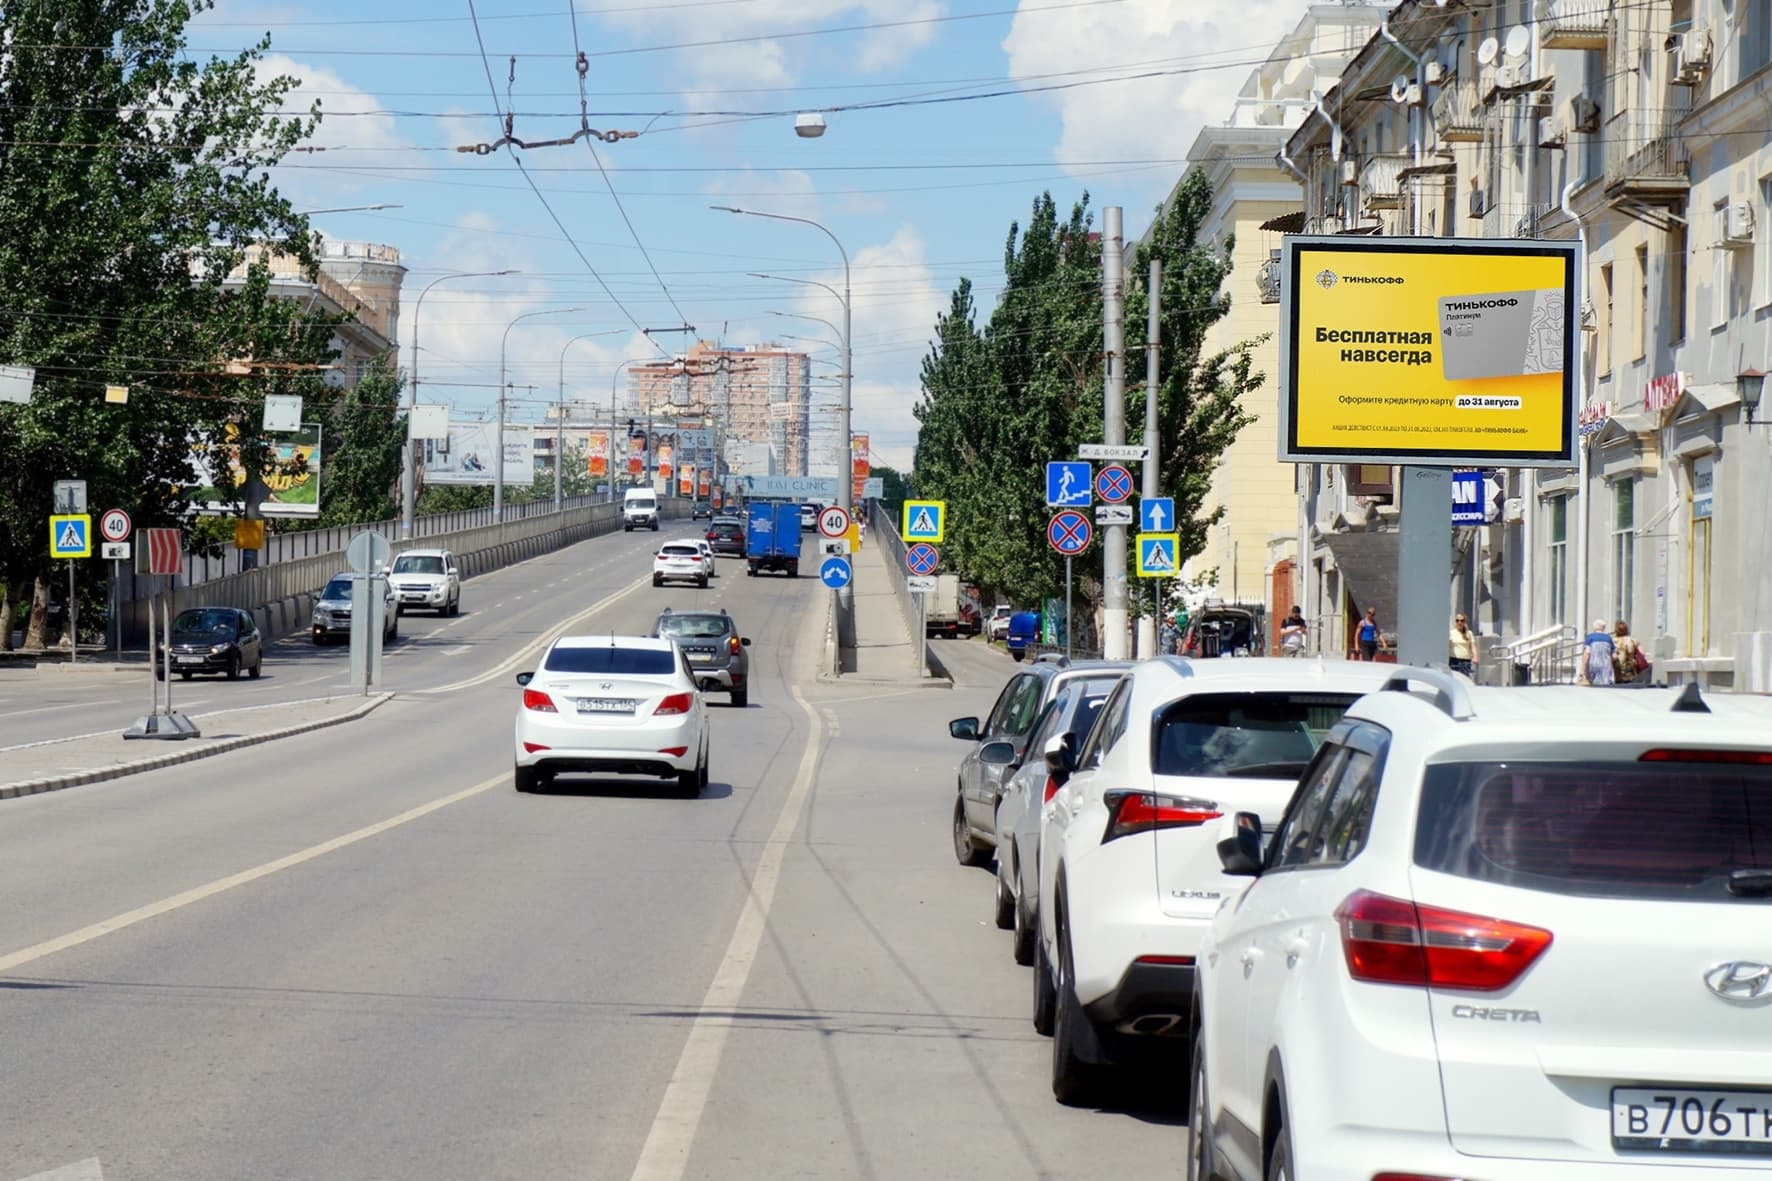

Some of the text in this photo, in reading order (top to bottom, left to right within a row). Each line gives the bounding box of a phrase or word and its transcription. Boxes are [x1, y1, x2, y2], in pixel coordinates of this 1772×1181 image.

[1342, 276, 1405, 285] ТИНЬКОФФ
[1445, 298, 1518, 311] ТИНЬКОФФ
[1446, 313, 1481, 321] Платинум
[1315, 327, 1432, 344] Бесплатная
[1341, 349, 1432, 365] навсегда
[1338, 395, 1519, 408] Оформите кредитную карту до 31 августа
[792, 482, 828, 491] CLINIC
[108, 519, 123, 532] 40
[826, 515, 842, 528] 40
[1452, 1005, 1542, 1024] CRETA
